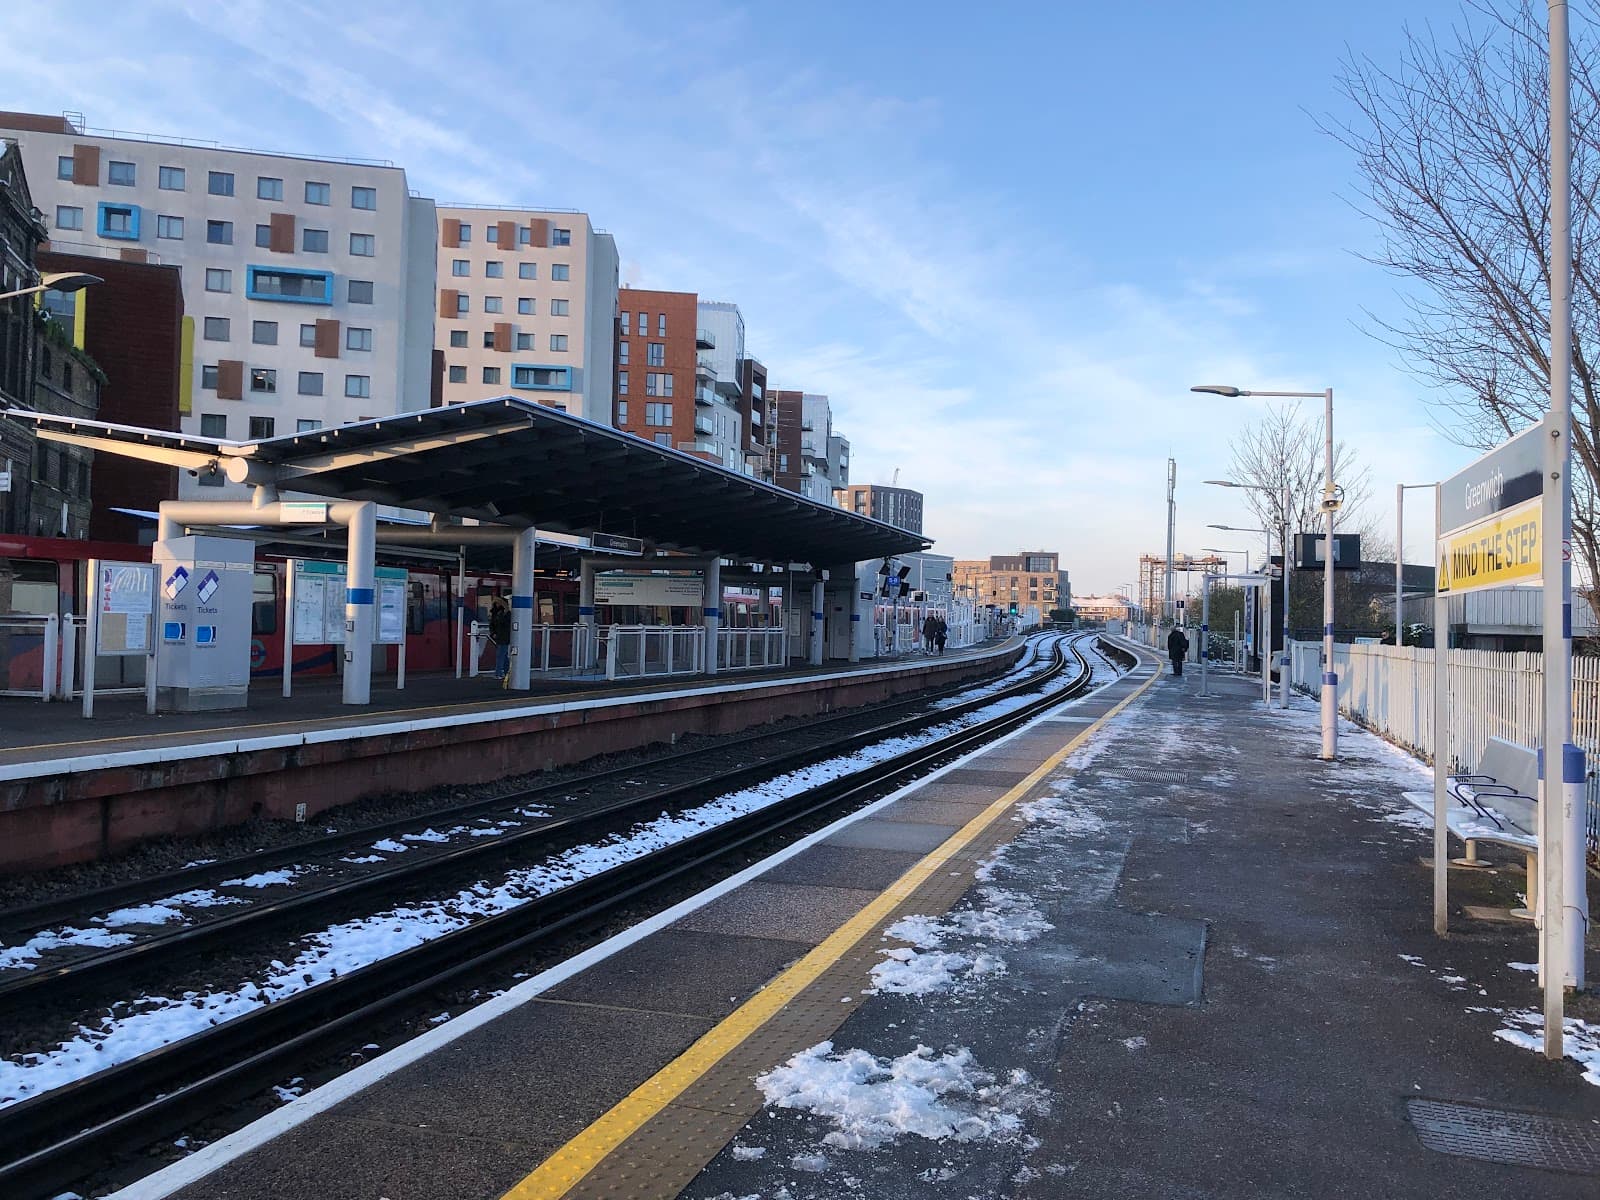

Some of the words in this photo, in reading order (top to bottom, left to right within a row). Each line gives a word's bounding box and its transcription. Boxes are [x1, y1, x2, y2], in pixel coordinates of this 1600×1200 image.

[1465, 466, 1503, 509] Greenwich
[1453, 543, 1477, 580] MIND
[1481, 533, 1502, 574] THE
[1506, 521, 1536, 568] STEP
[166, 603, 187, 611] Tickets
[197, 606, 218, 614] Tickets
